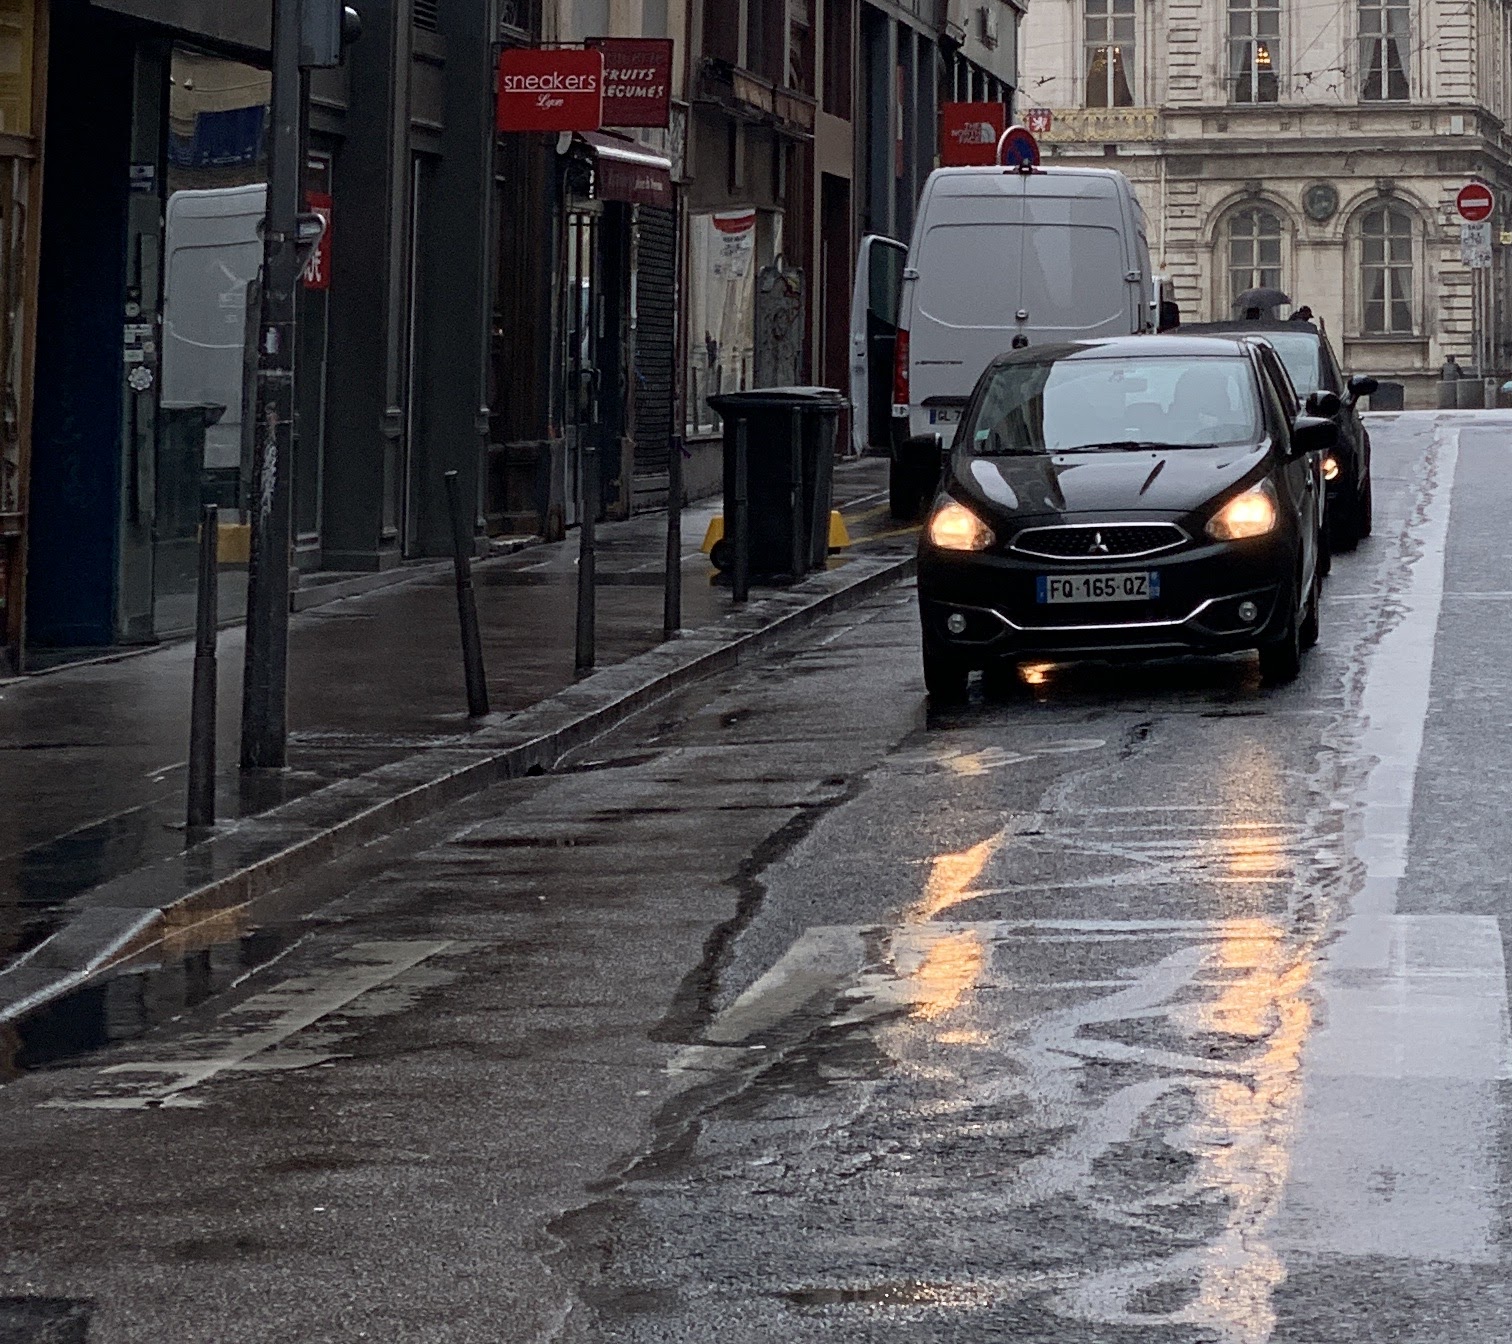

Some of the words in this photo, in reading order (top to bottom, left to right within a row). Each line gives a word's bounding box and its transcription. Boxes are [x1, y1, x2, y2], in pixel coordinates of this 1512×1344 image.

[504, 71, 596, 90] sneakers
[535, 93, 563, 111] Lyon
[1050, 576, 1147, 600] FQ-165-QZ
